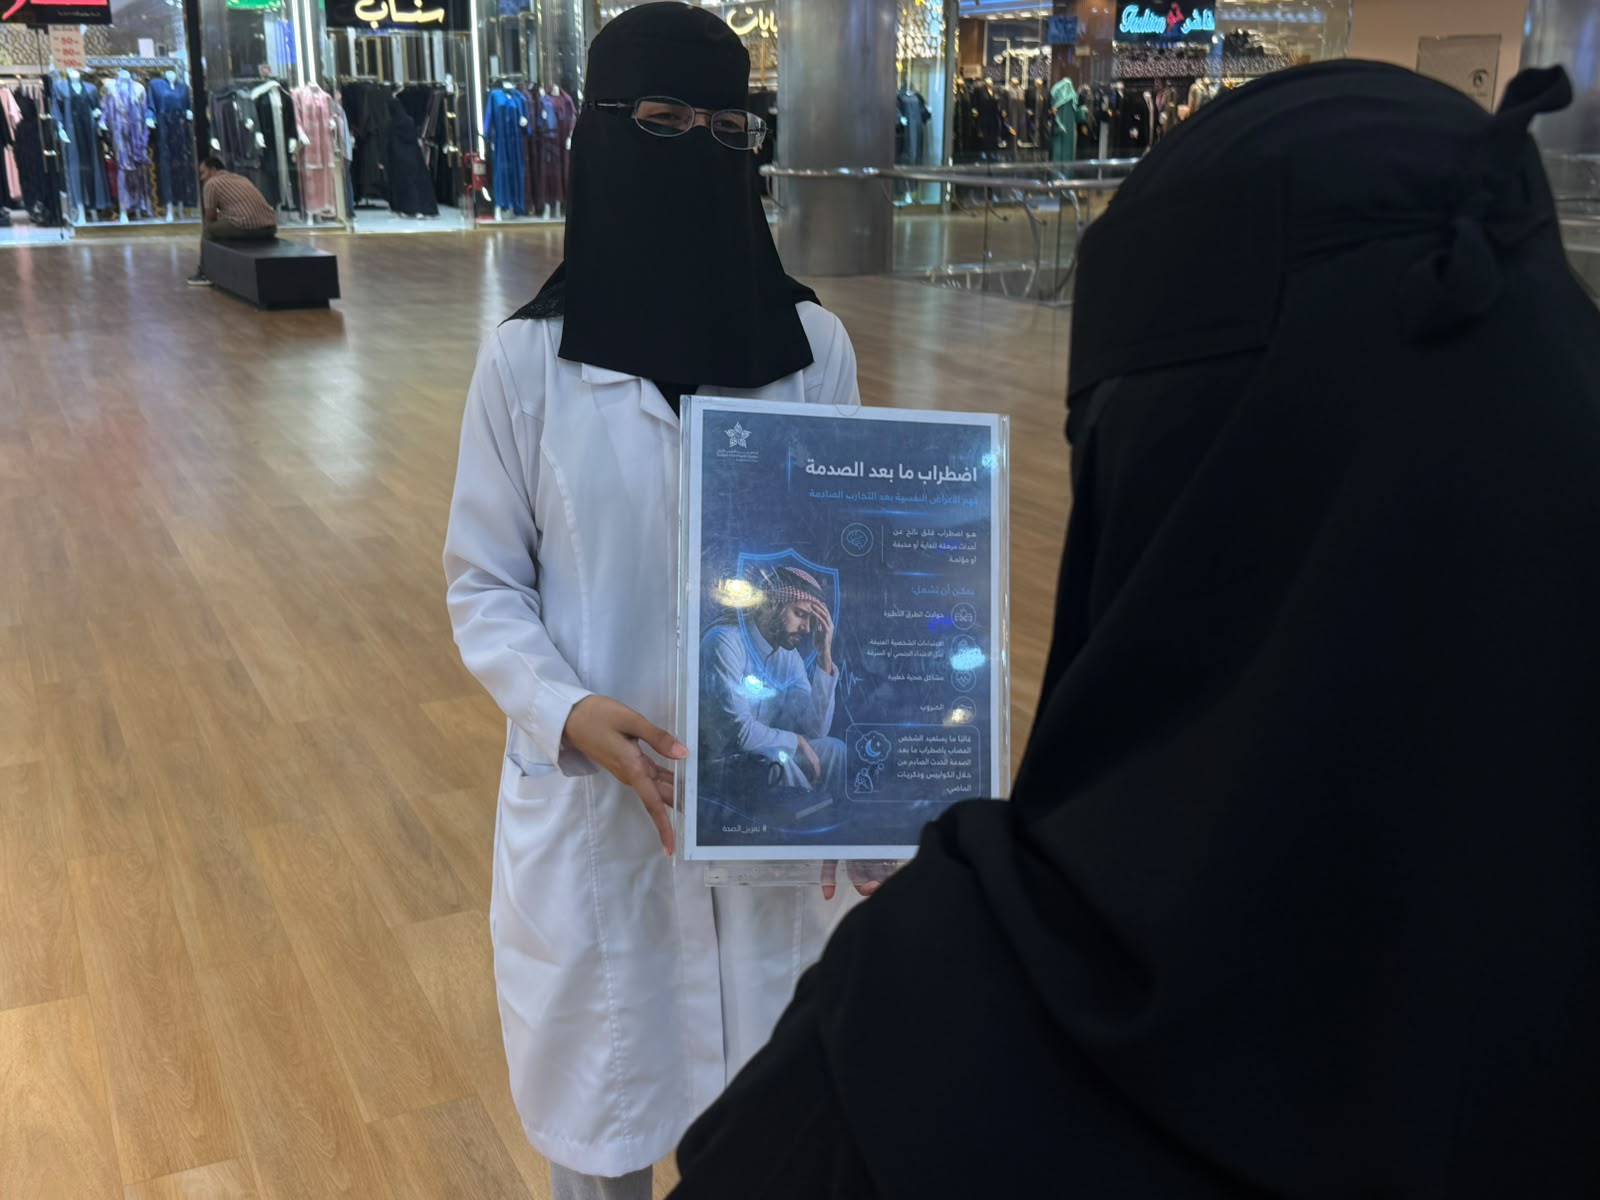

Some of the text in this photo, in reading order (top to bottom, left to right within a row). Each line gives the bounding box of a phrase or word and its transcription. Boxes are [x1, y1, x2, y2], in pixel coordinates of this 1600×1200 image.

[805, 458, 977, 485] اضطراب ما بعد الصدمة
[808, 488, 844, 499] الصادمة
[845, 490, 877, 502] التجارب
[879, 492, 893, 502] بعد
[895, 492, 928, 503] النفسية
[892, 528, 977, 539] هو اضطراب قلق ناتج عن
[892, 540, 912, 549] مخيفة
[912, 540, 919, 550] أو
[919, 541, 937, 550] للغاية
[959, 541, 977, 551] أحداث
[970, 555, 977, 565] أو
[940, 584, 950, 597] أن
[952, 585, 976, 597] يمكن
[883, 609, 905, 619] الخطيرة
[924, 610, 945, 619] حوادث
[869, 638, 889, 646] العنيفة
[890, 638, 916, 648] الشخصية
[893, 650, 913, 660] الجنسي
[888, 673, 944, 682] مشاكل صحية خطيرة
[920, 703, 944, 713] الحروب
[898, 734, 924, 743] الشخص
[925, 735, 948, 744] يستعيد
[949, 734, 956, 743] ما
[898, 746, 971, 755] المصاب باضطراب ما بعد
[897, 758, 971, 768] الصدمة الحدث الصادم من
[926, 770, 956, 780] الكوابيس
[957, 771, 972, 780] خلال
